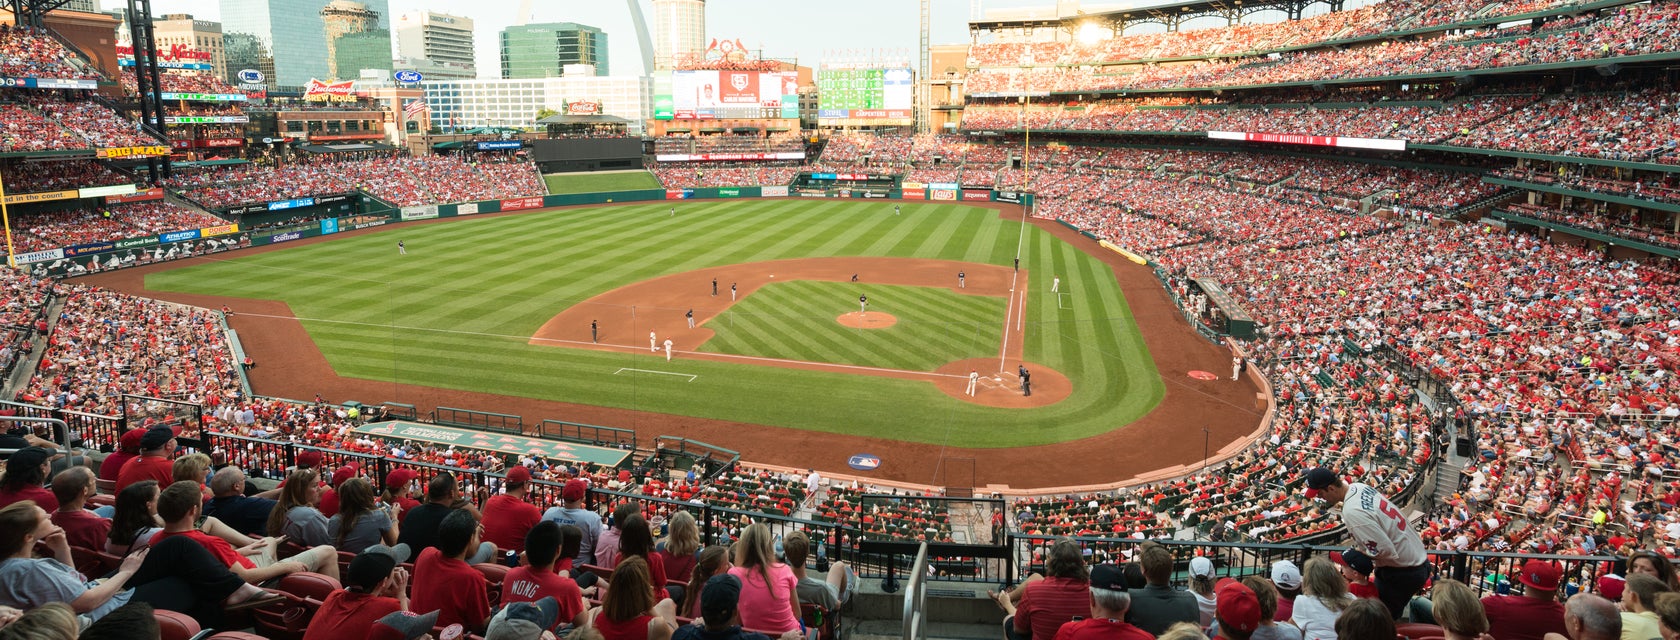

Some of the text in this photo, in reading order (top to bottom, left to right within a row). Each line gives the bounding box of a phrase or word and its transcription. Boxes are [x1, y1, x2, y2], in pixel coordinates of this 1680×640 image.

[164, 44, 211, 61] Nation
[245, 71, 258, 79] FOX
[400, 72, 418, 80] Ford
[239, 83, 267, 91] MIDWEST
[309, 83, 355, 94] Budweiser
[106, 146, 165, 158] BIG MAC
[124, 238, 144, 246] Central
[273, 232, 300, 242] Scottrade
[1379, 499, 1406, 531] 5
[511, 580, 540, 599] WONG
